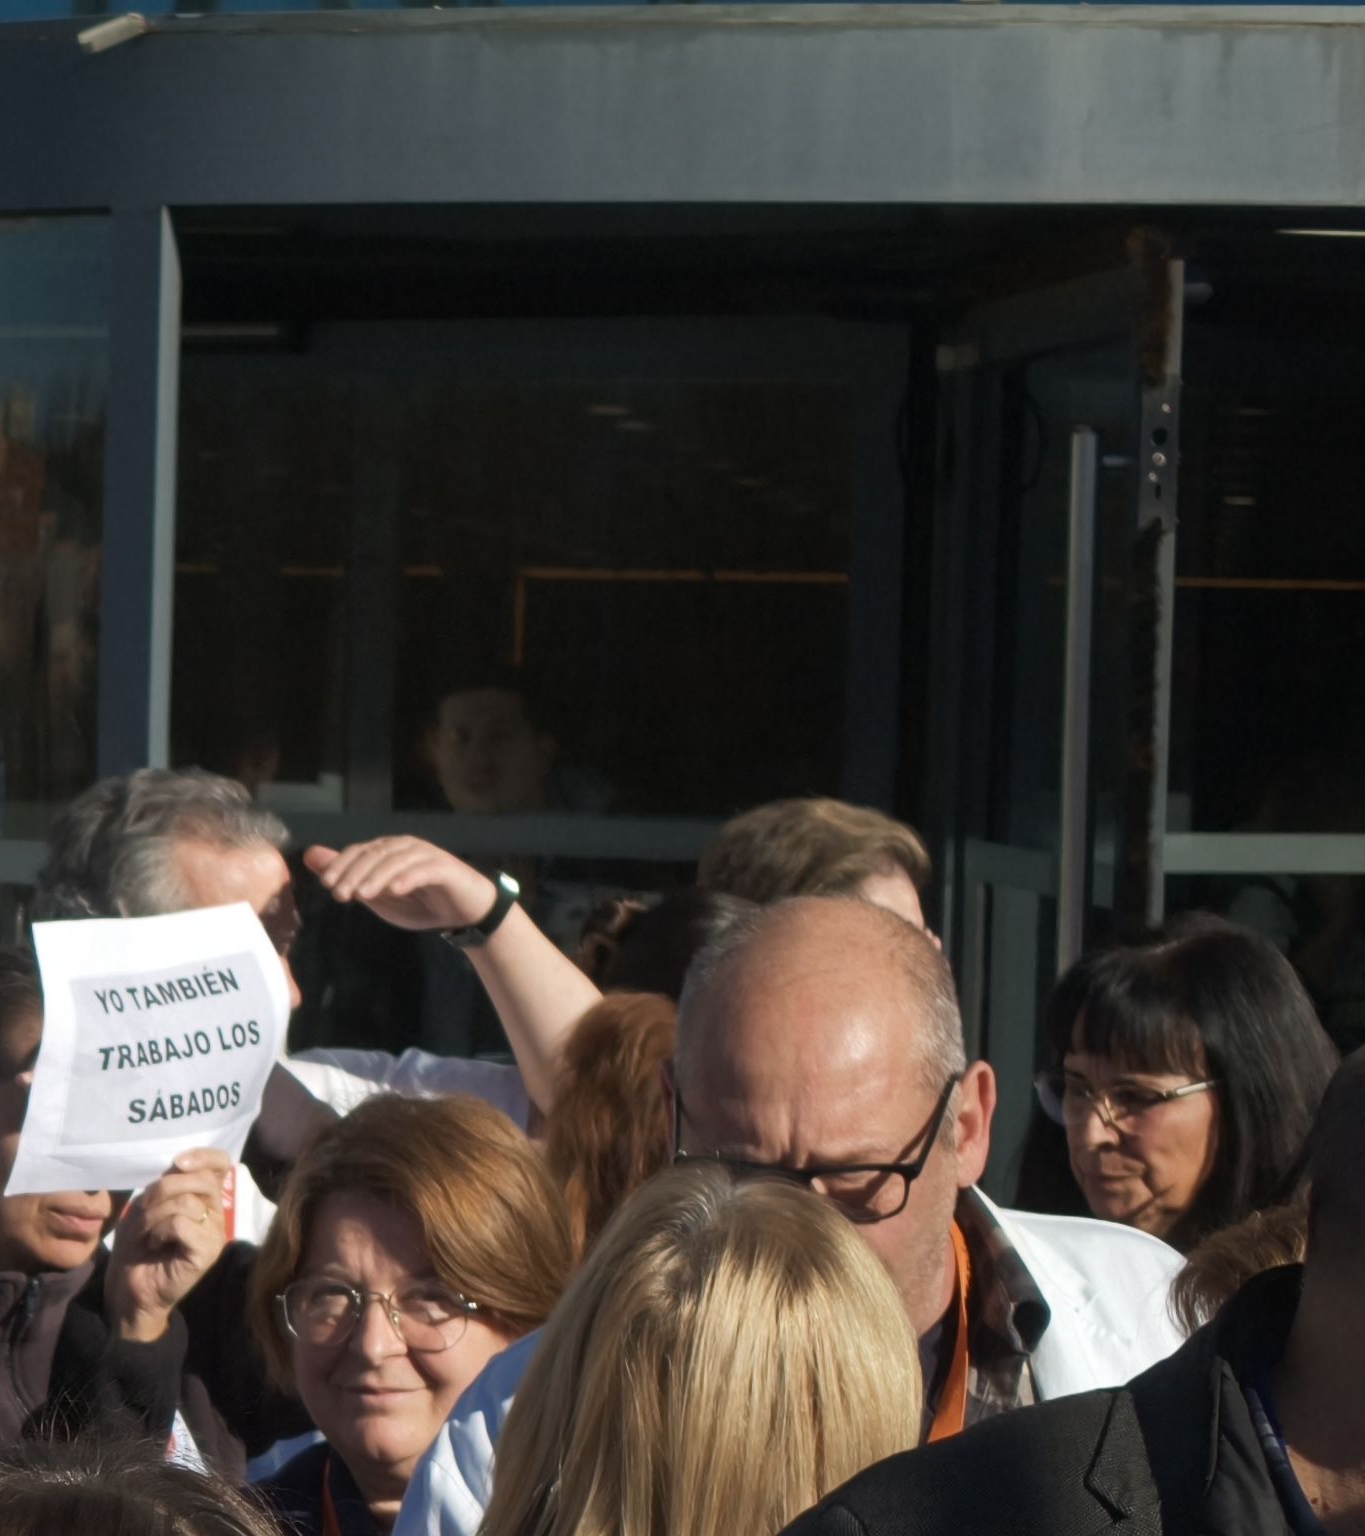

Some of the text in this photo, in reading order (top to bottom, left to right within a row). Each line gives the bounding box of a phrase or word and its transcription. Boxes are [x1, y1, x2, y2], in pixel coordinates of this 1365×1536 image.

[94, 966, 239, 1015] YO TAMBIÉN
[98, 1020, 261, 1071] TRABAJO LOS
[127, 1082, 241, 1124] SÁBADOS
